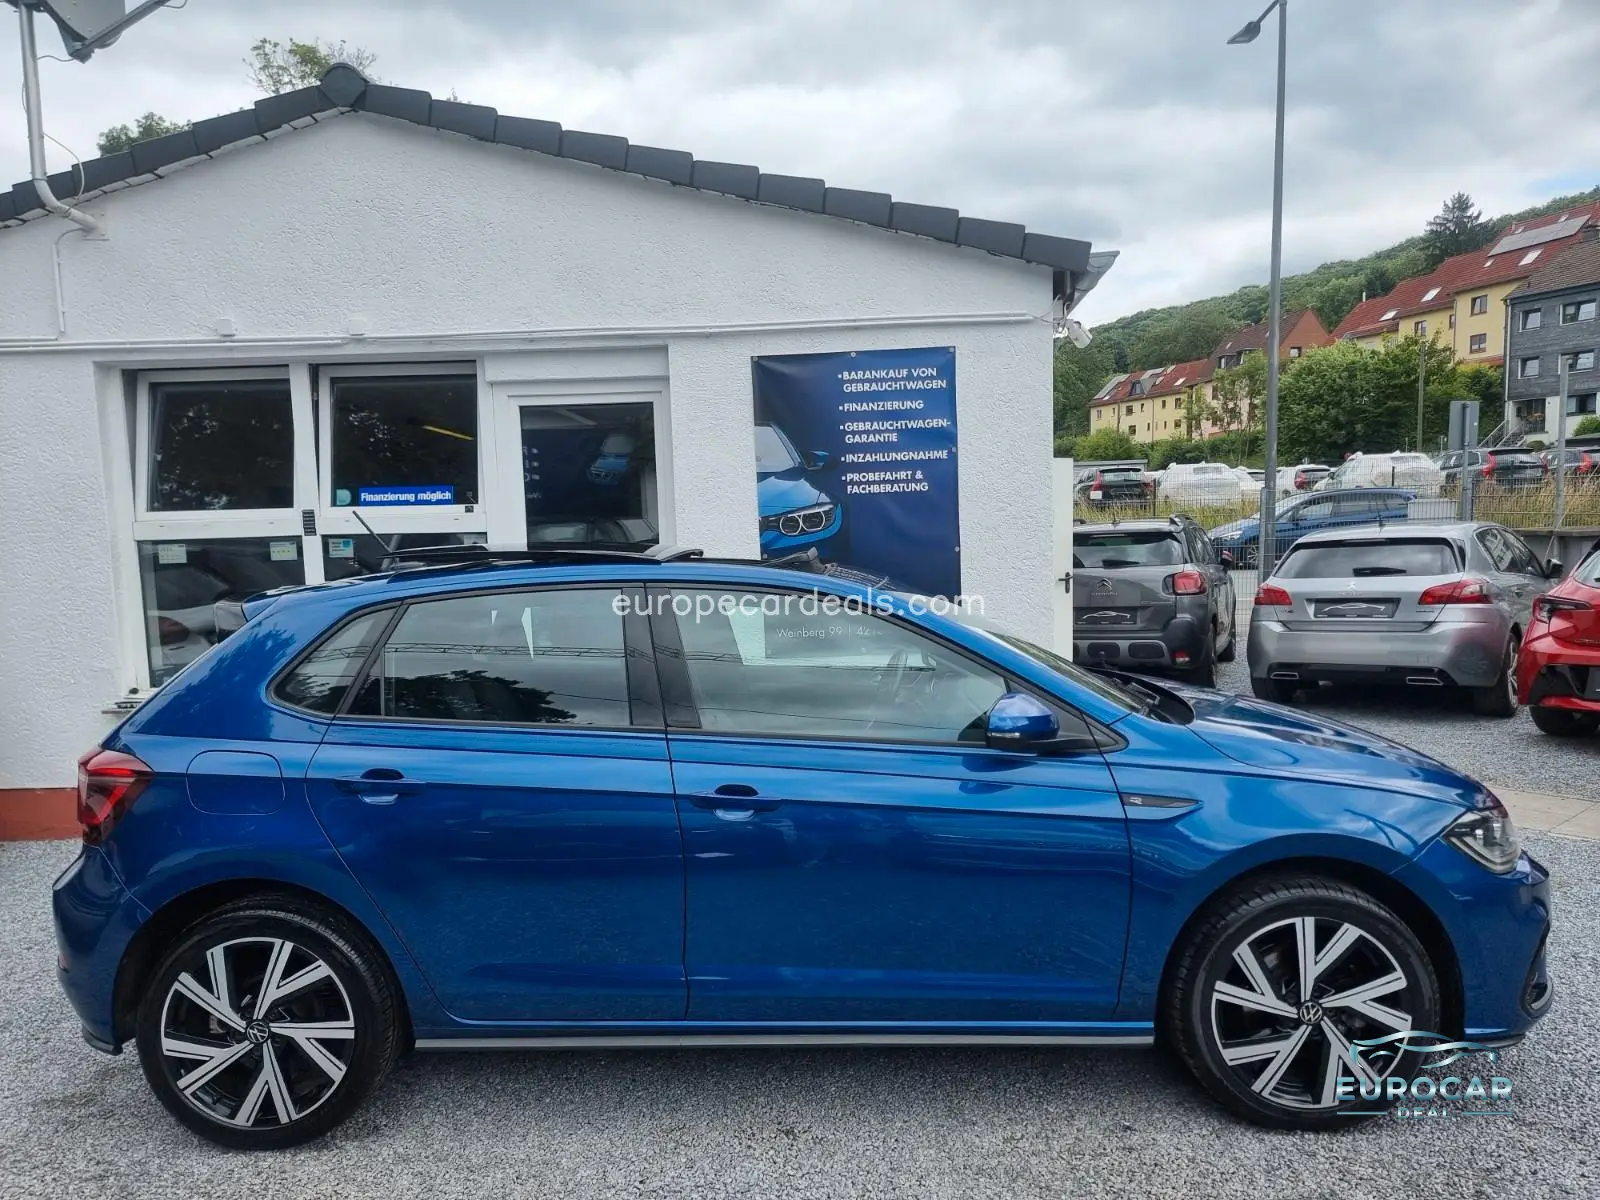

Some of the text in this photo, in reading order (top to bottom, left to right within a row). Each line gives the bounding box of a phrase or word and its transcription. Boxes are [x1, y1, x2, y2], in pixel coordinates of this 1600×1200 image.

[842, 367, 937, 380] BARANKAUF VON
[843, 380, 947, 392] GEBRAUCHTWAGEN
[844, 400, 924, 412] FINANZIERUNG
[844, 419, 951, 432] GEBRAUCHTWAGEN-
[845, 433, 898, 444] GARANTIE
[846, 450, 949, 463] INZAHLUNGNAHME
[846, 470, 924, 482] PROBEFAHRT &
[847, 482, 929, 494] FACHBERATUNG
[360, 490, 452, 503] Finanzierung möglich
